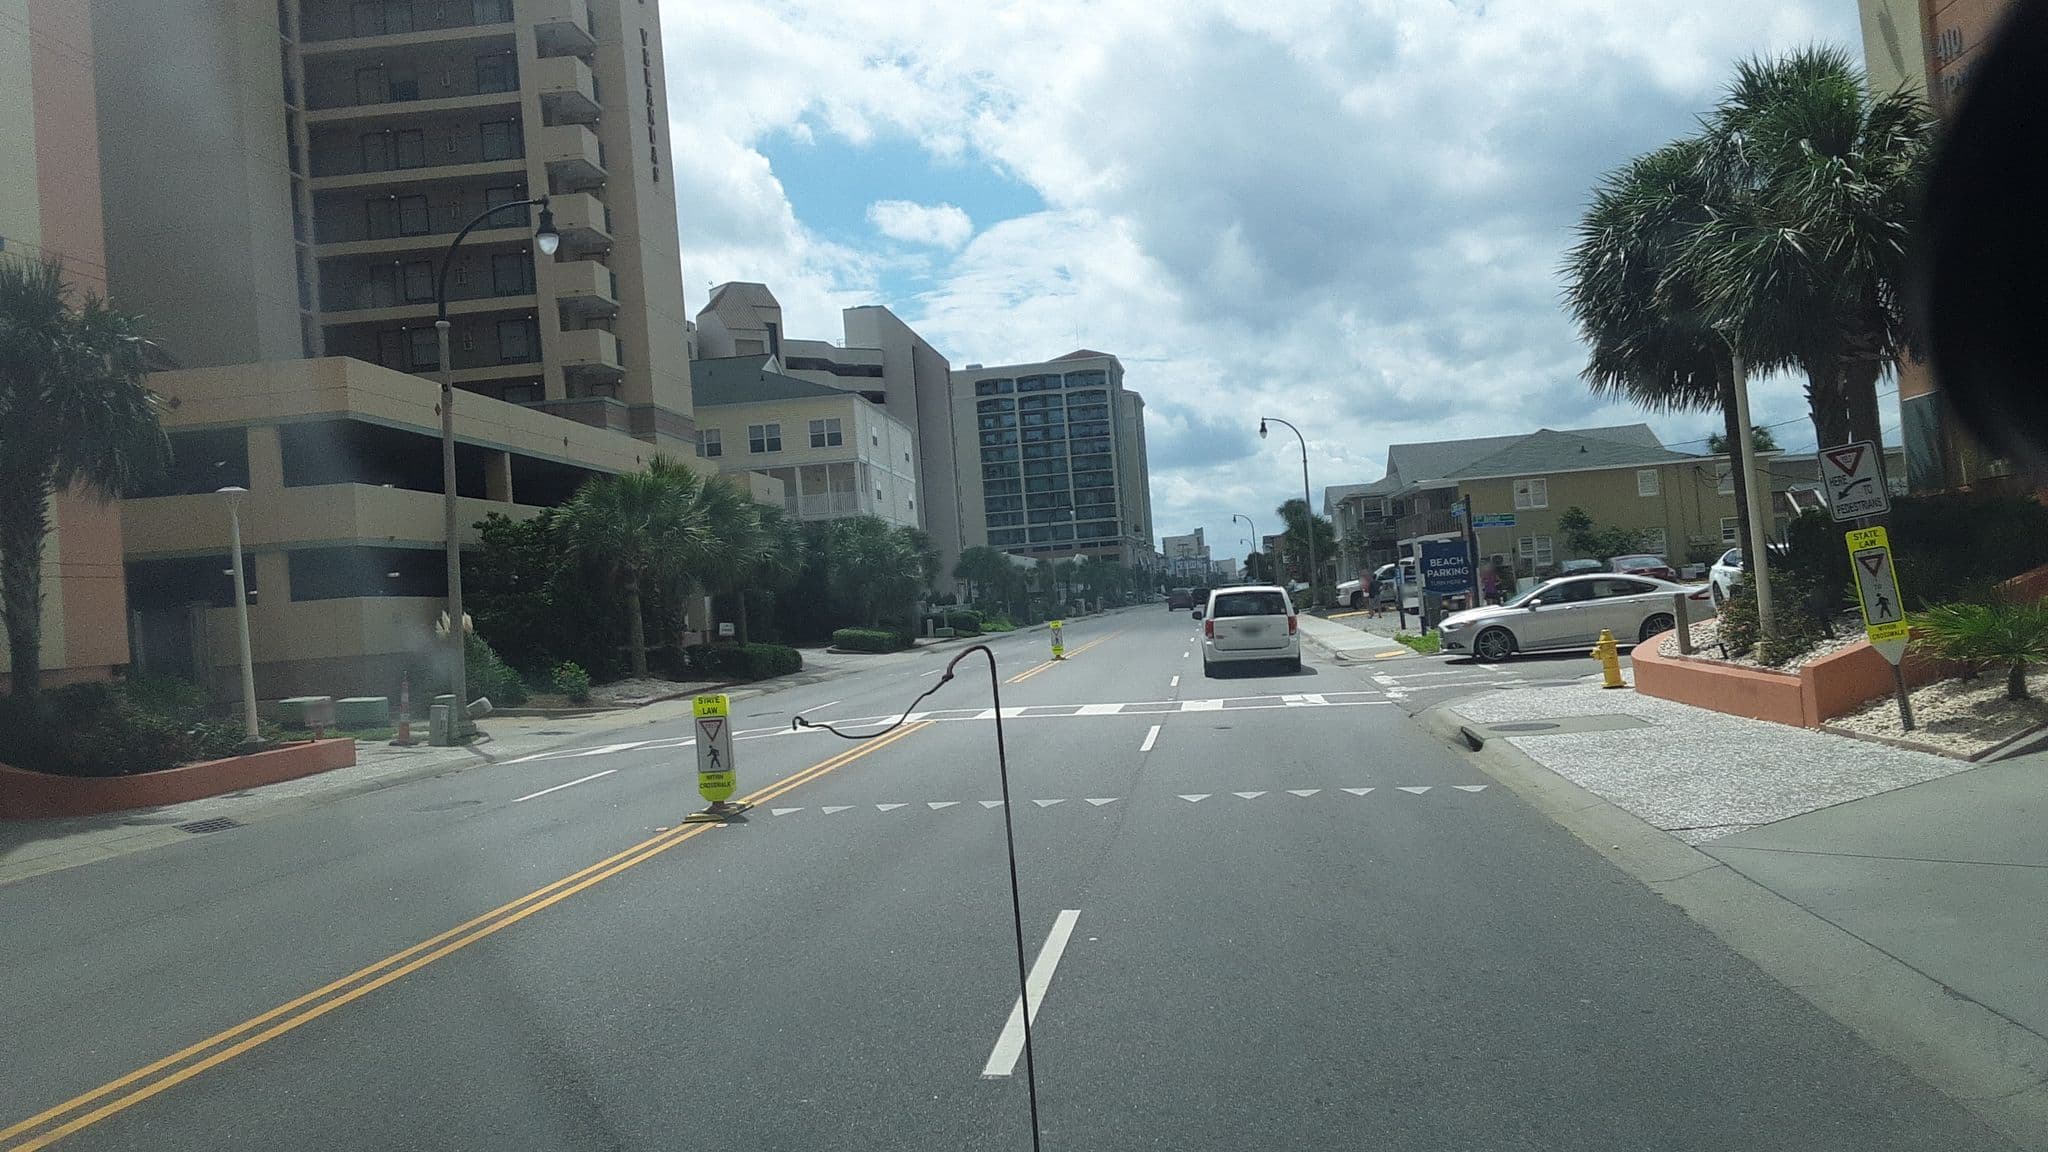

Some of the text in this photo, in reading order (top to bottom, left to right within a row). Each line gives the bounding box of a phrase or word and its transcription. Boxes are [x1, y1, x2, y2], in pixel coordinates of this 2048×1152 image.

[1829, 475, 1848, 487] HERE
[1863, 485, 1873, 496] TO
[1836, 498, 1883, 514] PEDESTRIANS
[1853, 531, 1879, 542] STATE
[1859, 539, 1877, 548] LAW
[1430, 556, 1464, 567] BEACH
[1427, 567, 1469, 578] PARKING
[1872, 630, 1905, 641] CROSSWALK
[698, 696, 720, 704] STATE
[702, 707, 718, 715] LAW
